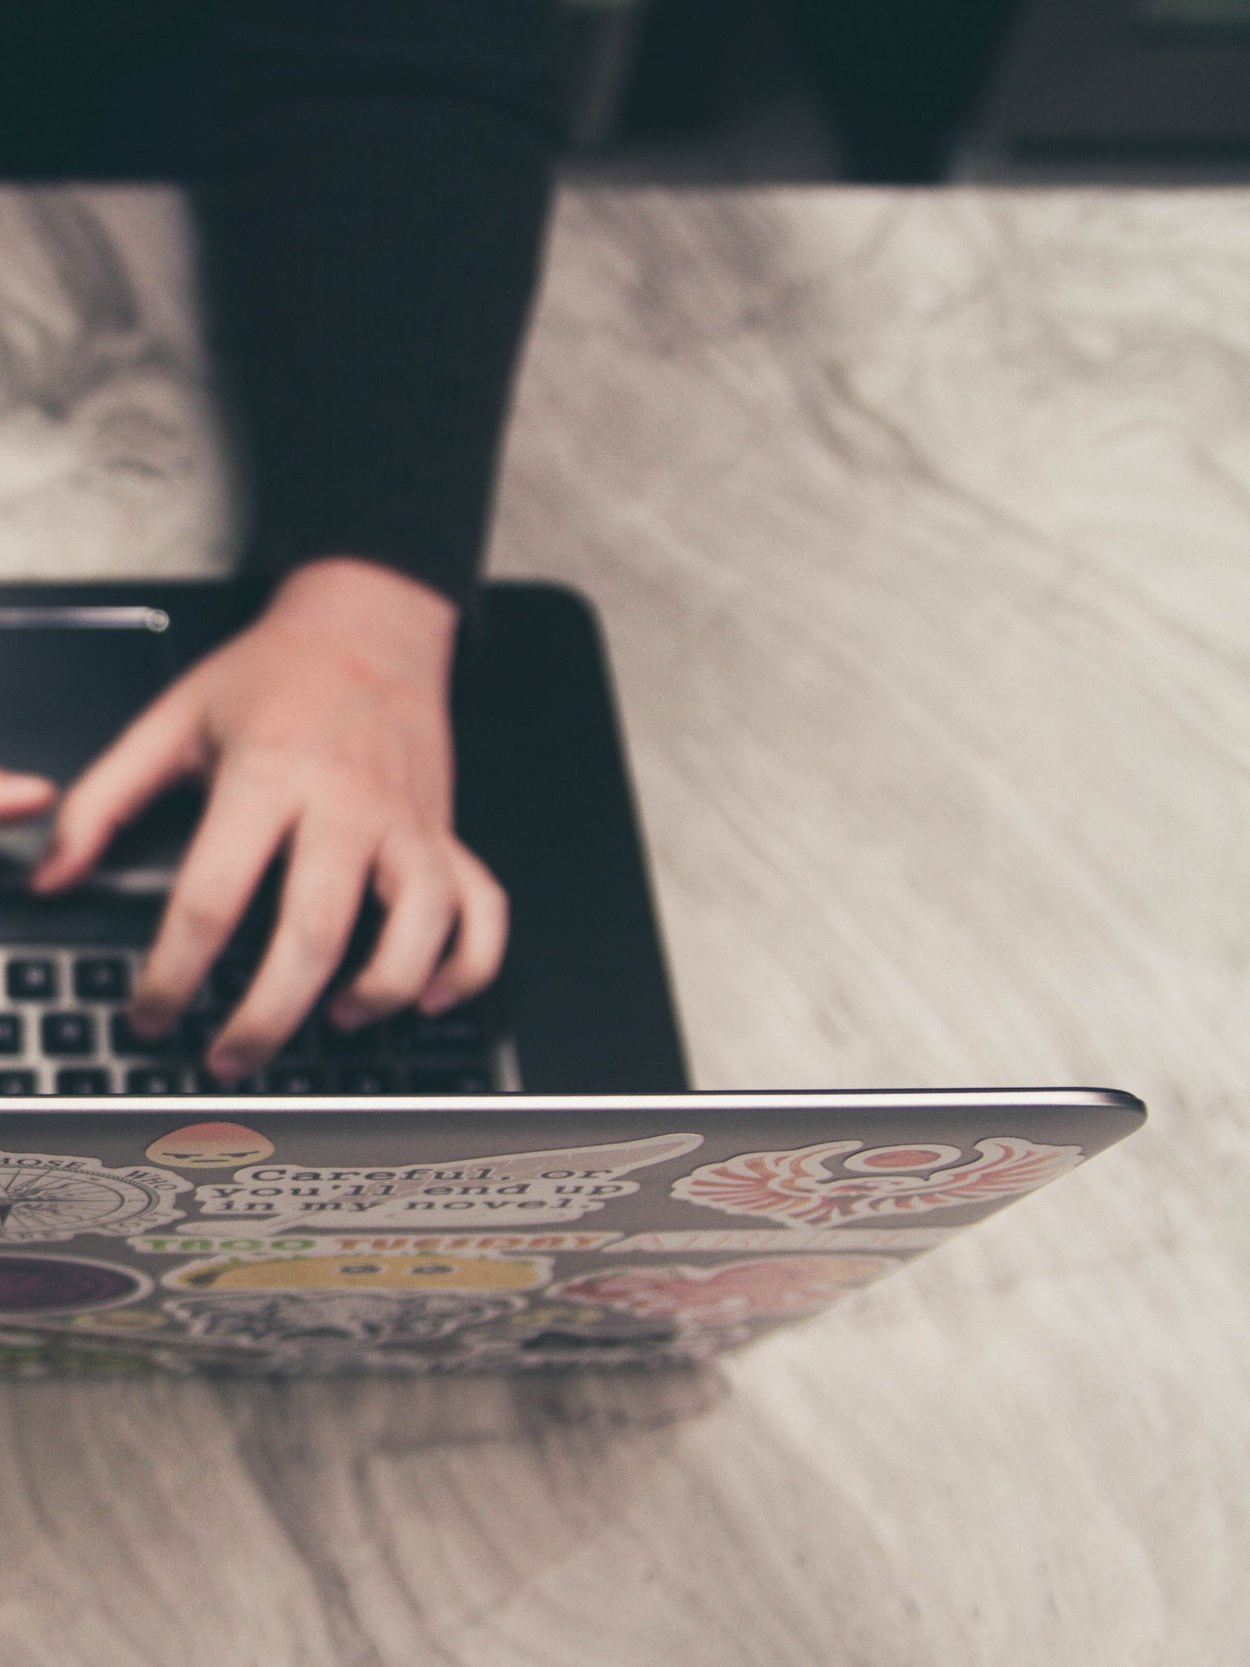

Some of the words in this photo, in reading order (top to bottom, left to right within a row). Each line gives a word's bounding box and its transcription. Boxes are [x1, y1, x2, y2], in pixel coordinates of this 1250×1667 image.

[123, 1170, 178, 1191] WHO
[540, 1168, 613, 1179] or
[210, 1184, 396, 1199] you'll
[422, 1183, 531, 1196] end
[554, 1184, 624, 1196] up
[216, 1200, 276, 1211] in
[299, 1201, 384, 1212] my
[144, 1238, 317, 1250] TACO
[333, 1235, 602, 1250] TUESDAY
